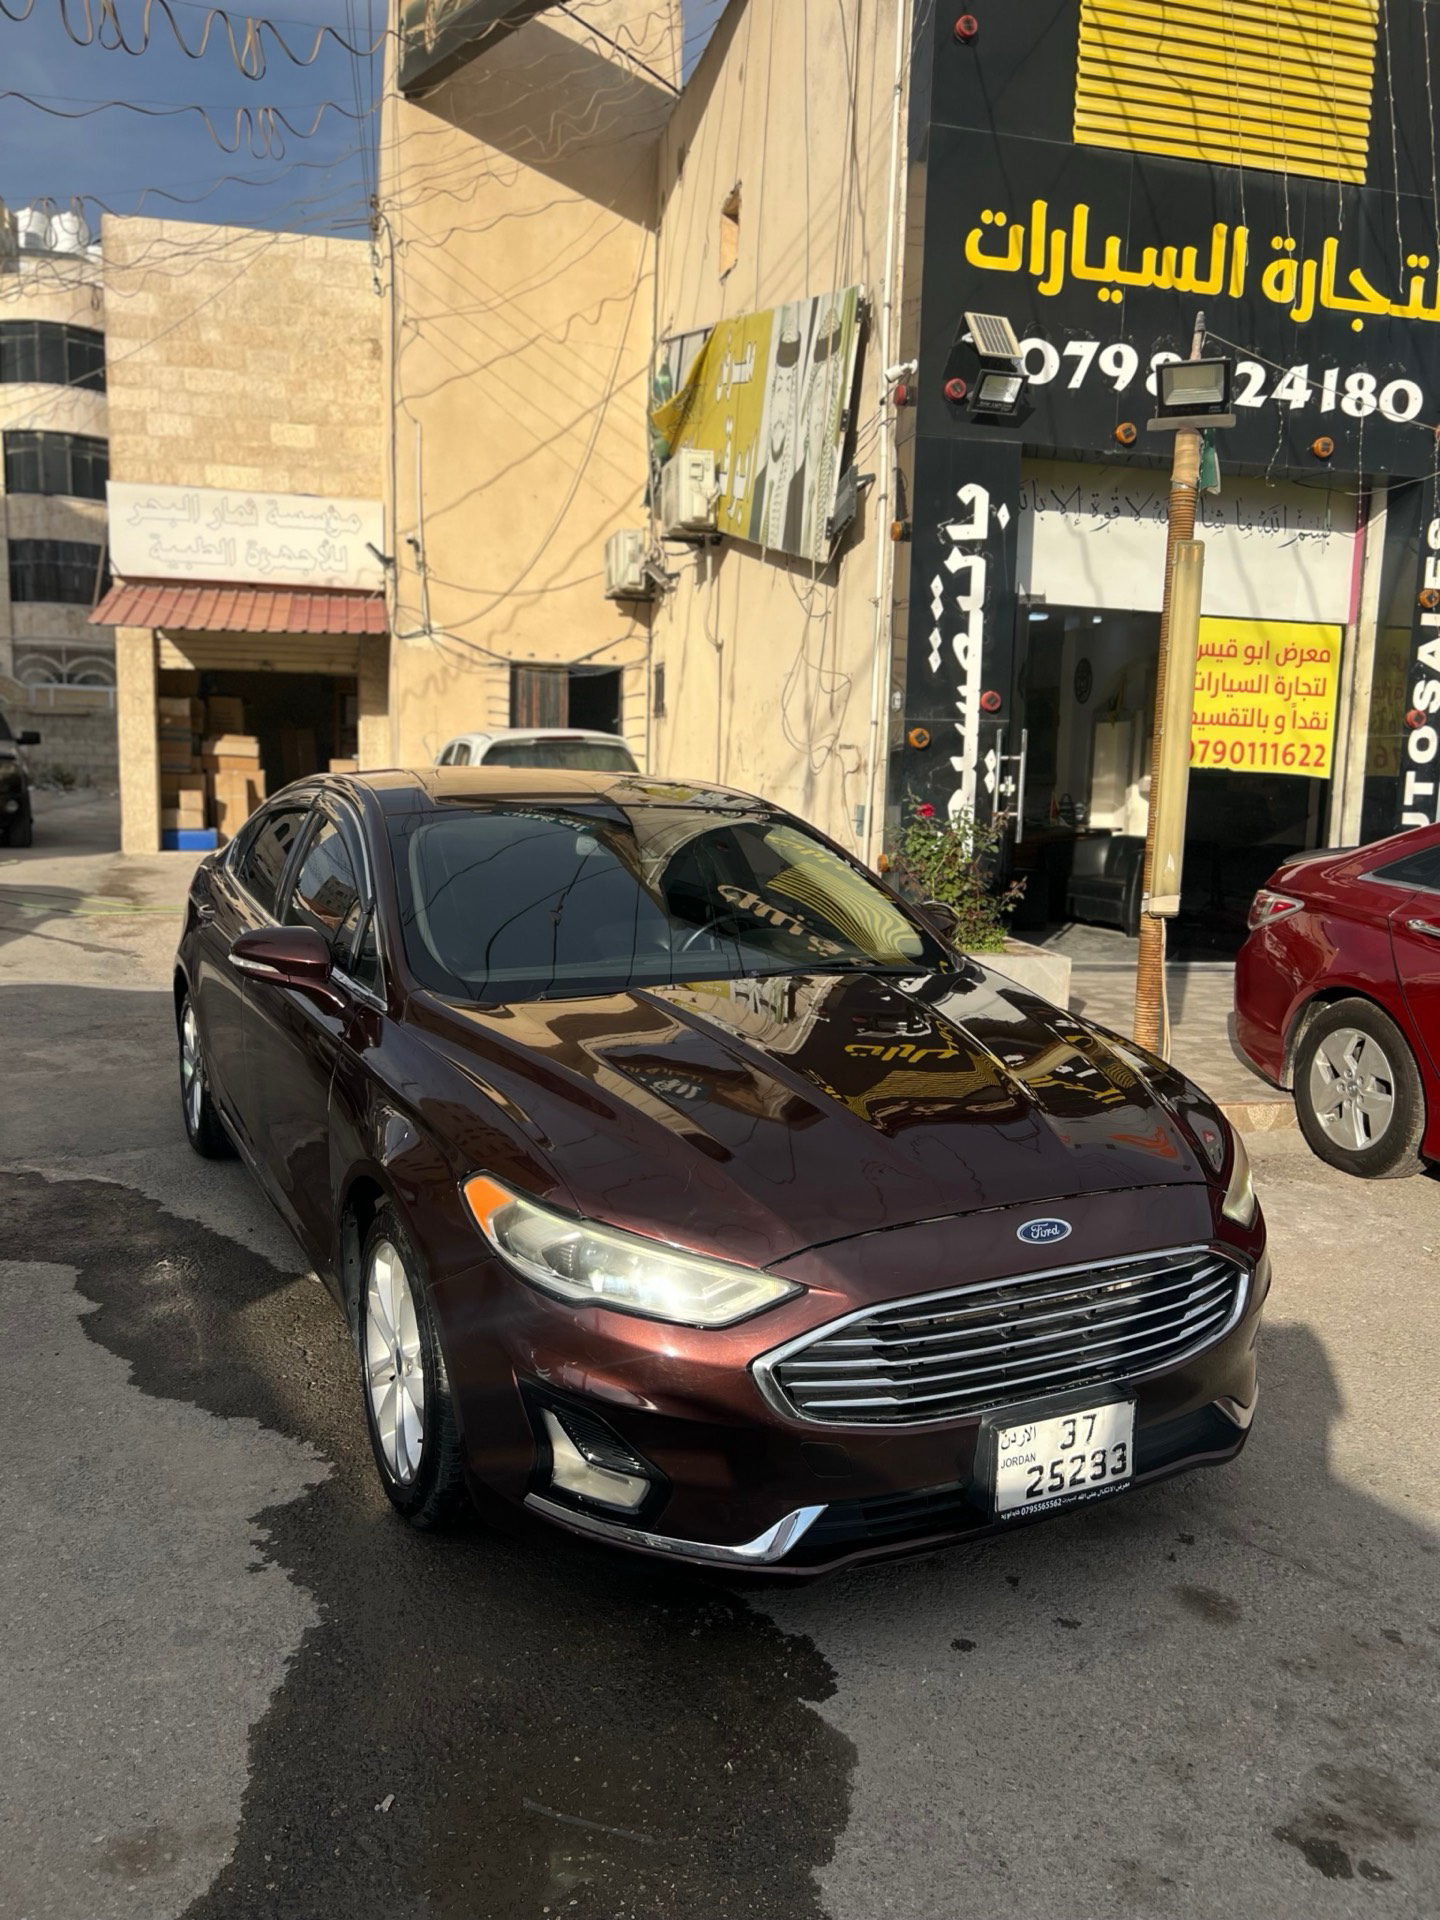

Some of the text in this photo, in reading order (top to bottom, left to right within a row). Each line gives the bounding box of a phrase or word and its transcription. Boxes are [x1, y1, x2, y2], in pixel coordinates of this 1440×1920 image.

[965, 200, 1249, 303] السيارات
[126, 493, 362, 538] مؤسسة ثمار البحر
[1200, 494, 1226, 536] شا
[148, 532, 237, 570] الطبية
[1243, 640, 1270, 665] ابو
[1275, 642, 1331, 668] معرض
[1274, 676, 1327, 701] لتجارة
[1191, 707, 1269, 733] بالتقسي
[1273, 715, 1286, 735] و
[1031, 1223, 1060, 1239] Ford
[1060, 1414, 1097, 1449] 37
[1001, 1452, 1036, 1469] JORDAN
[1026, 1441, 1127, 1499] 25233
[1020, 1498, 1062, 1516] 0795565562
